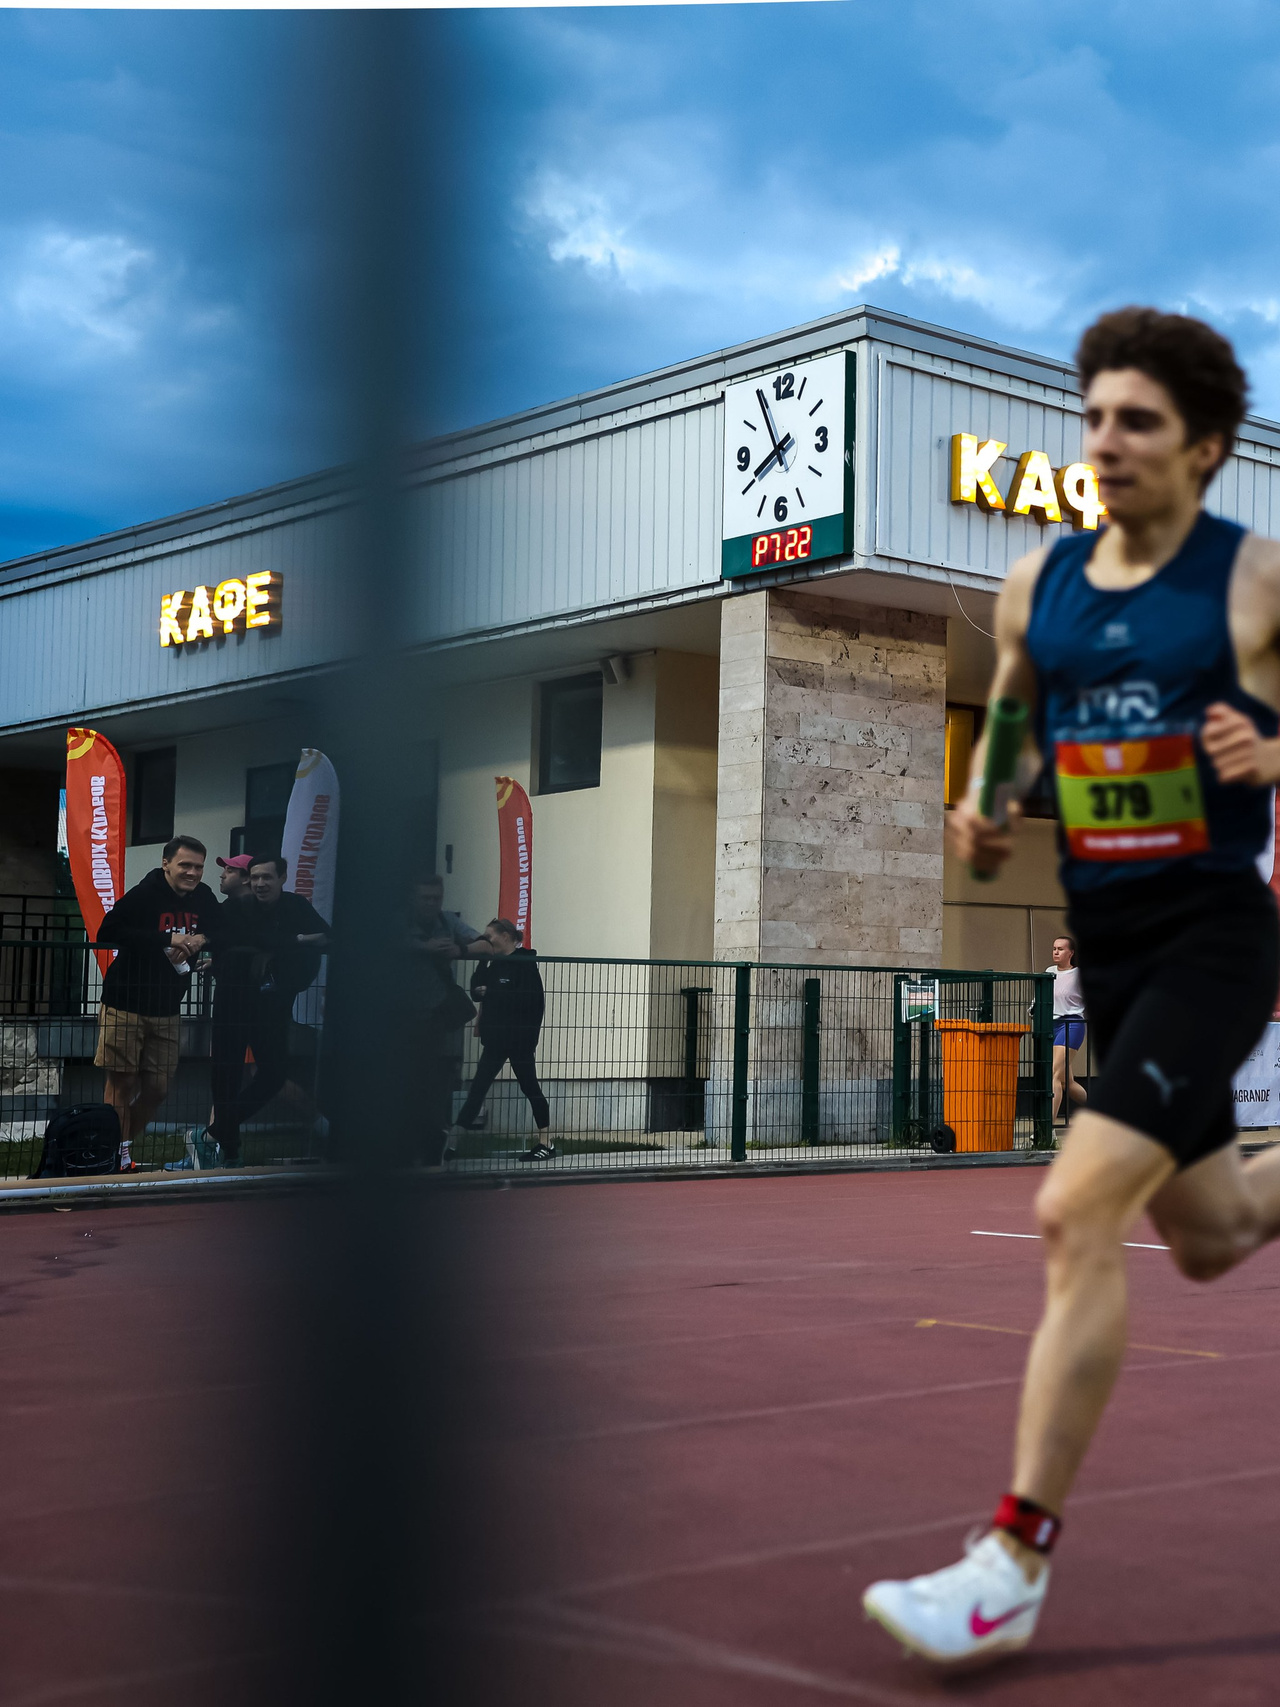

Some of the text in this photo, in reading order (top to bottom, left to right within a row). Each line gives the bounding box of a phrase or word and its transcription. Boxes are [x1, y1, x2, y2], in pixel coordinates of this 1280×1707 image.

[773, 373, 795, 401] 12
[815, 426, 829, 453] 3
[737, 446, 750, 472] 9
[952, 432, 1108, 530] КАФ
[774, 496, 788, 522] 6
[160, 570, 276, 648] КАФЕ
[1088, 780, 1154, 823] 379
